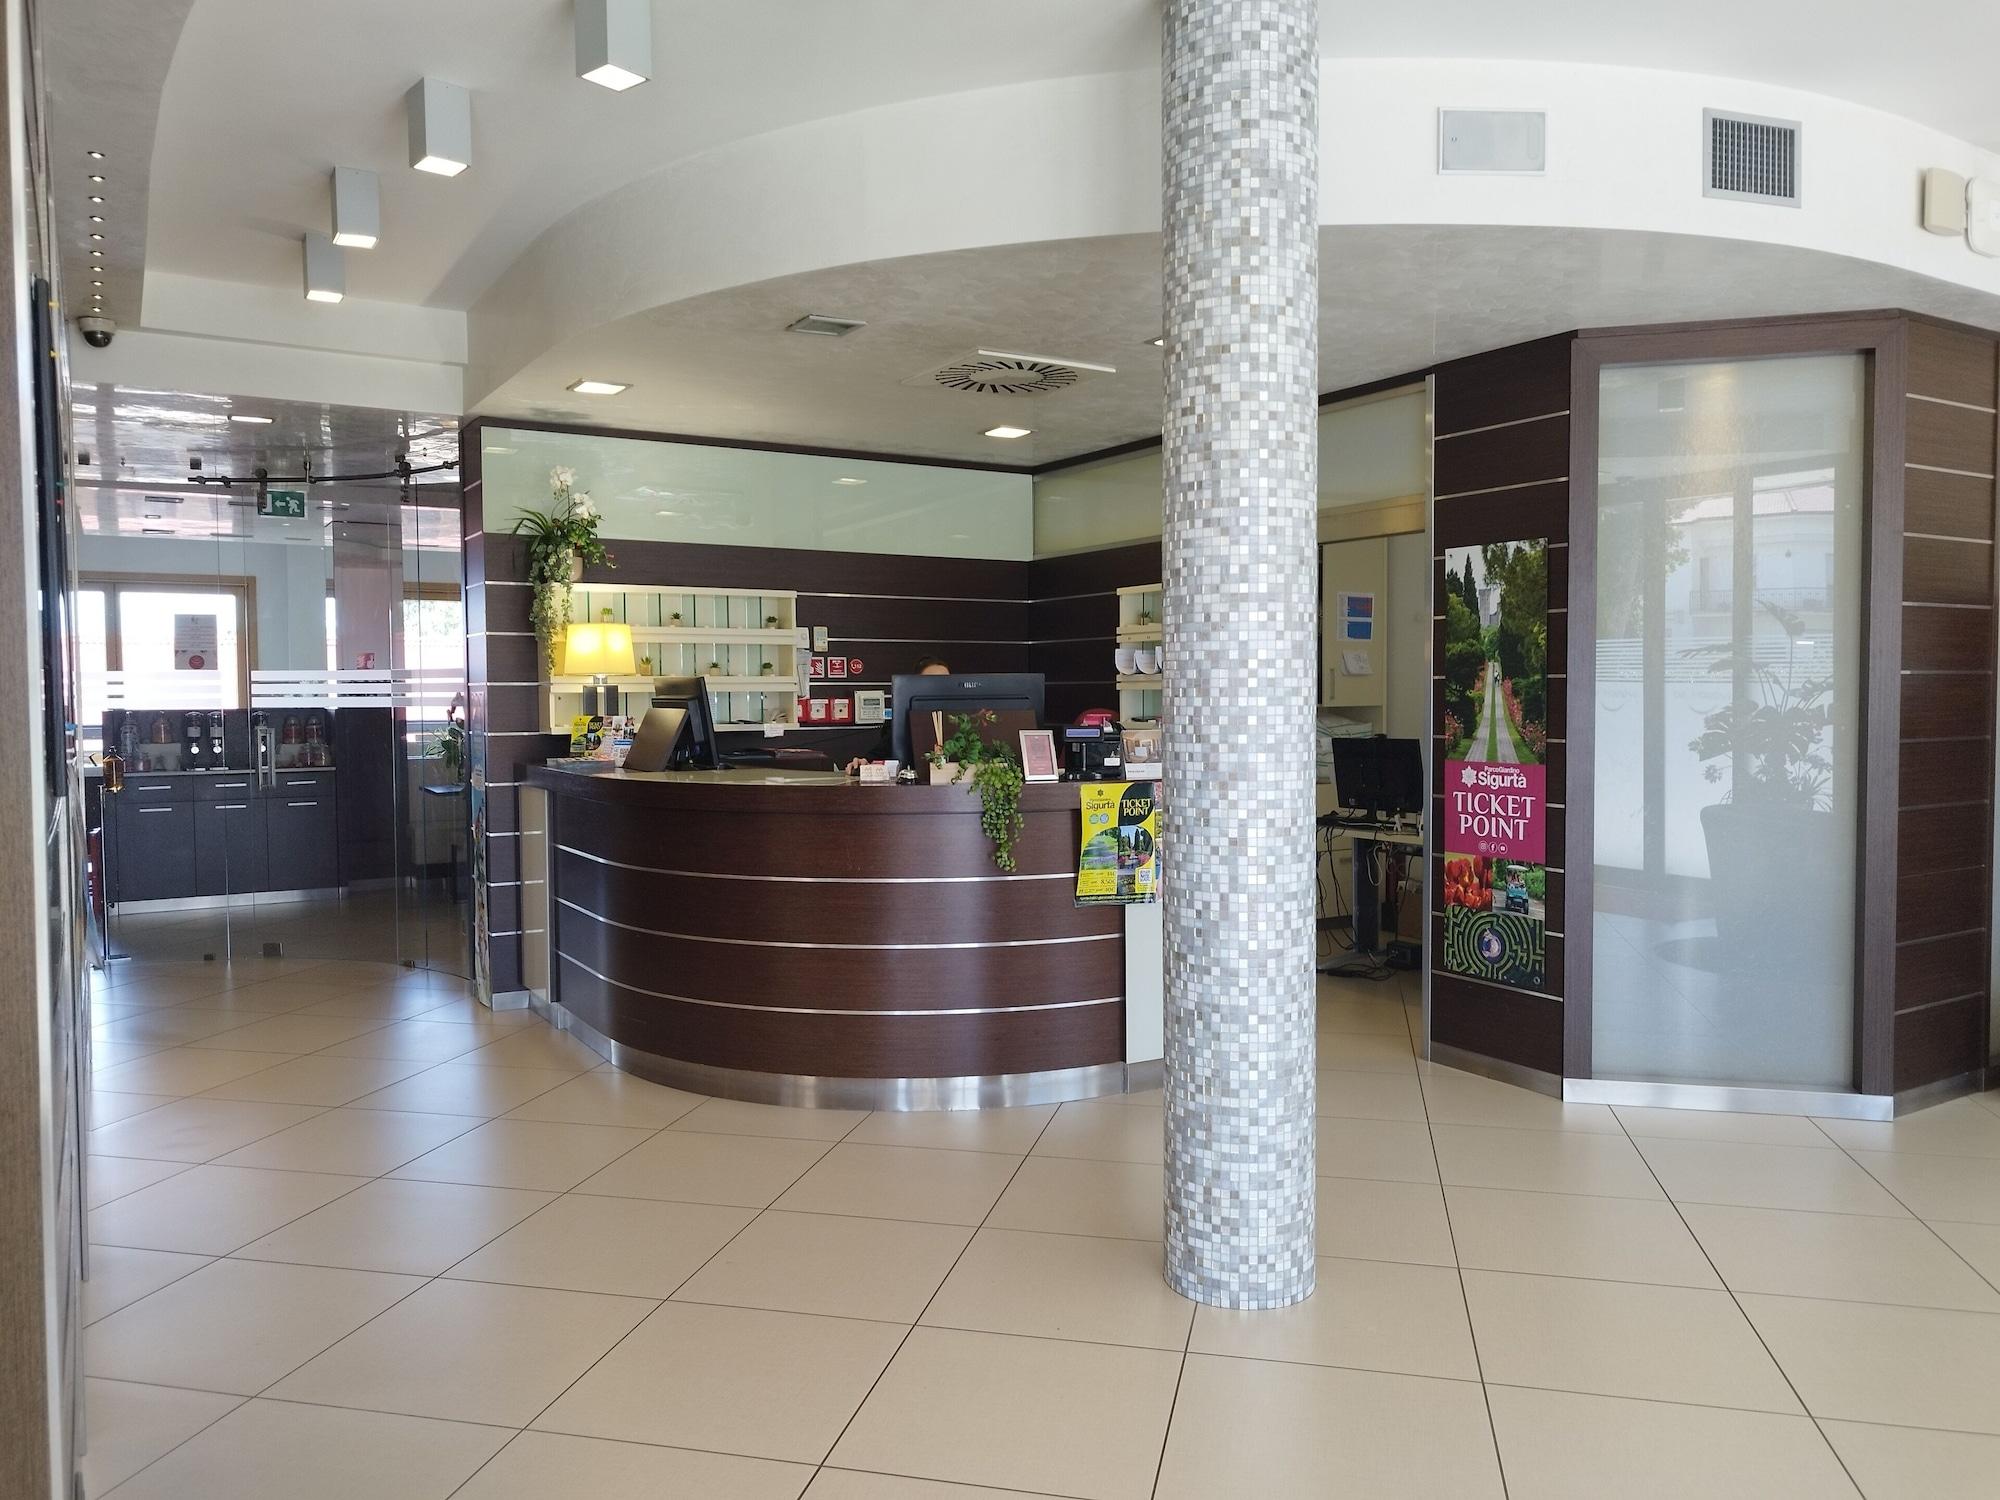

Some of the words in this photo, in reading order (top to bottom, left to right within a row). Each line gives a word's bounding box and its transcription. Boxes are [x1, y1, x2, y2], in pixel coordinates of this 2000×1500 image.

[1478, 772, 1527, 790] Sigurtà
[1122, 798, 1152, 808] TICKET
[1123, 806, 1149, 817] POINT
[1453, 791, 1536, 818] TICKET
[1459, 813, 1529, 841] POINT
